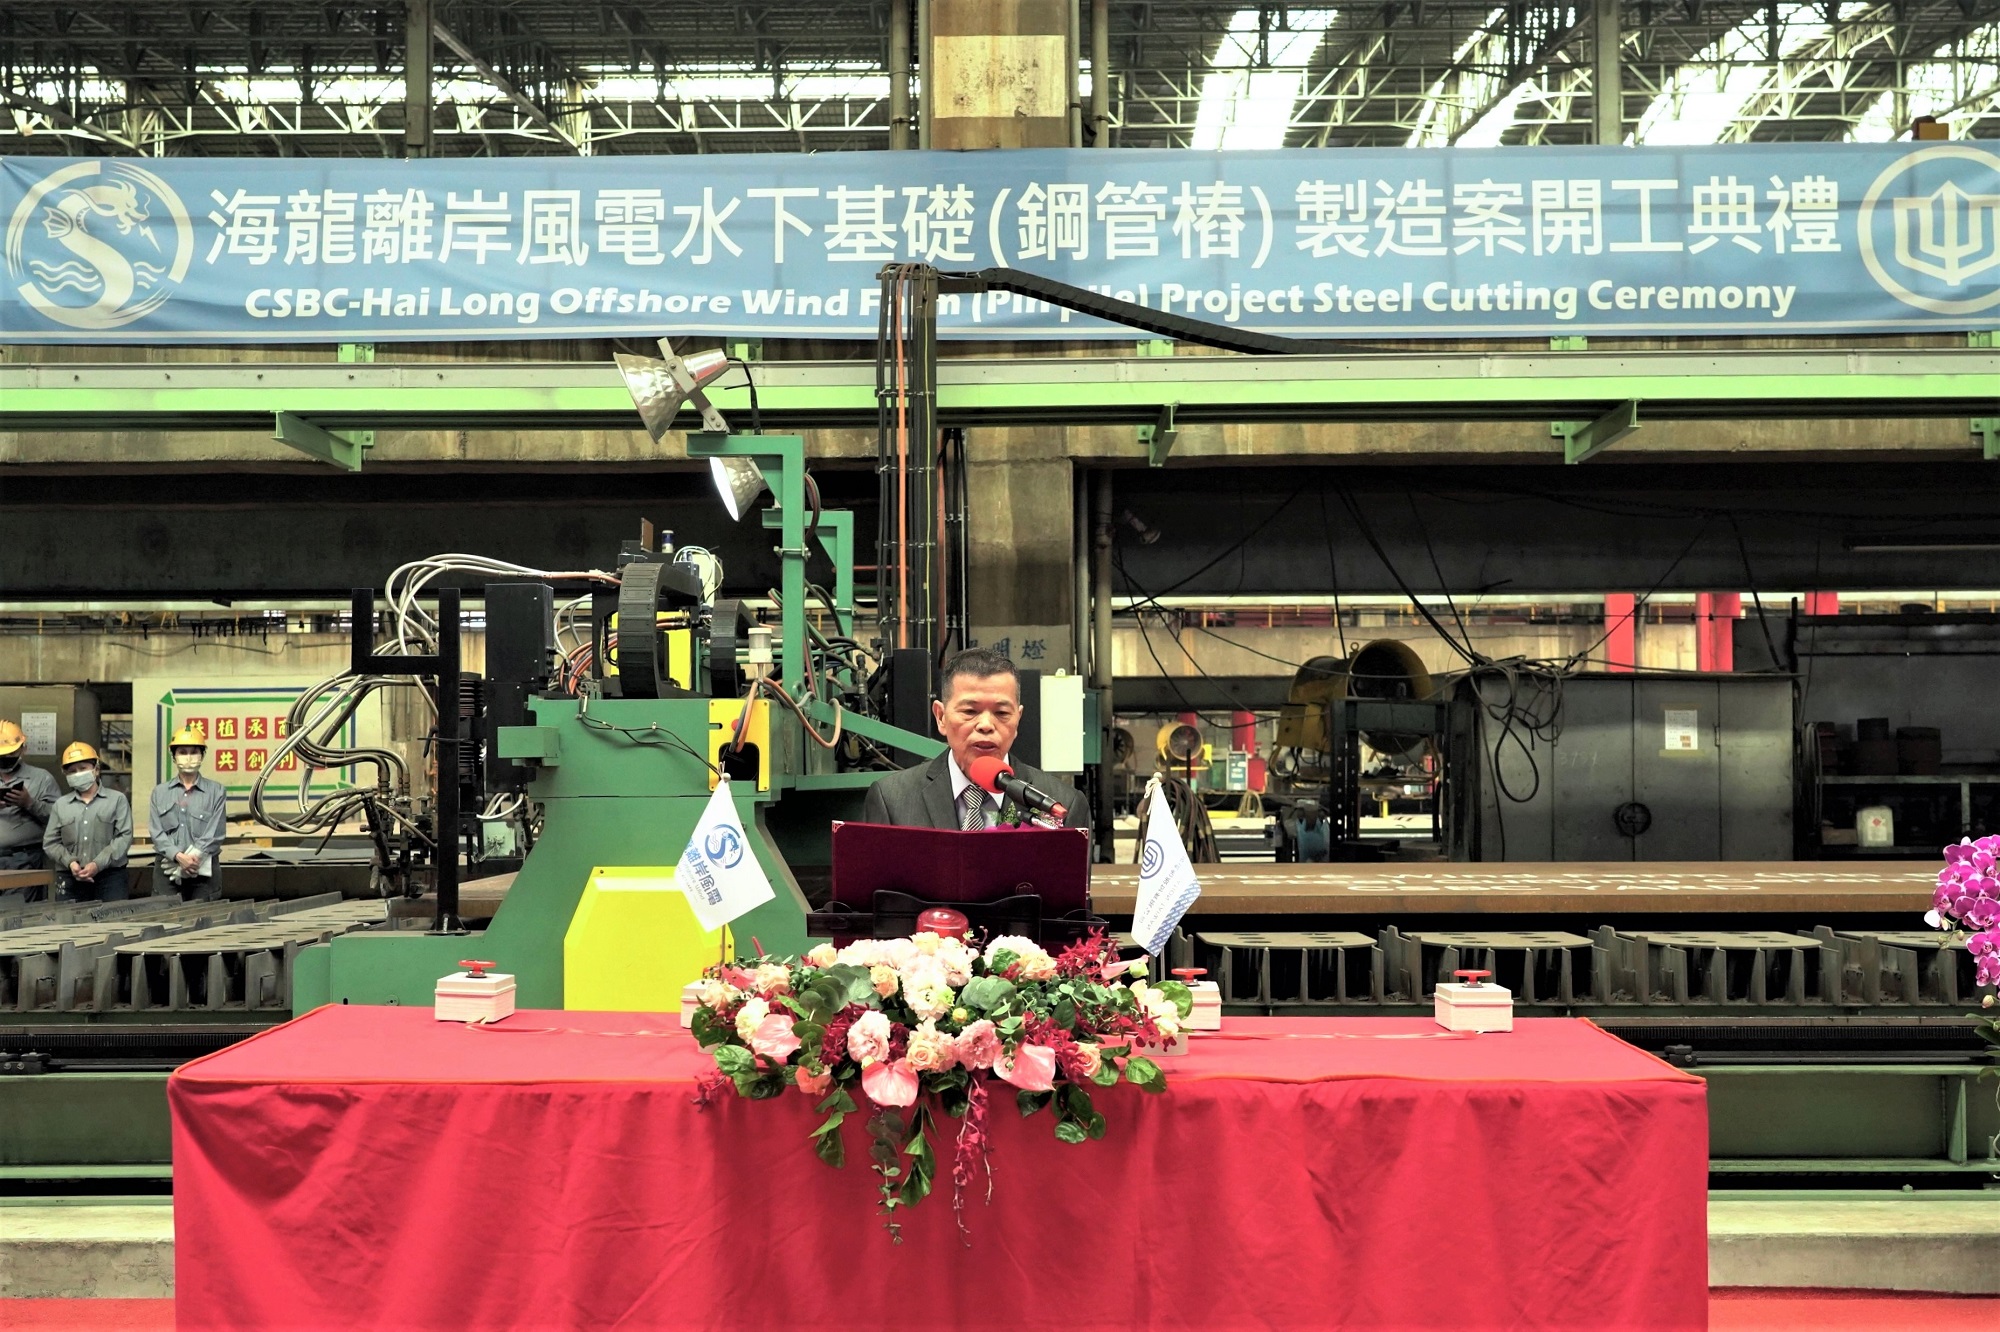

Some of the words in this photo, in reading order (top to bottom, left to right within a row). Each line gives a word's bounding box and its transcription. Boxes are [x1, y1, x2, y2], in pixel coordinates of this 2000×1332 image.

[245, 287, 430, 318] CSBC-Hai
[440, 287, 541, 325] Long
[549, 286, 731, 317] Offshore
[742, 288, 849, 317] Wind
[859, 288, 962, 317] Fm
[1162, 282, 1304, 322] Project
[1313, 281, 1413, 314] Steel
[1422, 280, 1578, 320] Cutting
[1587, 279, 1797, 319] Ceremony
